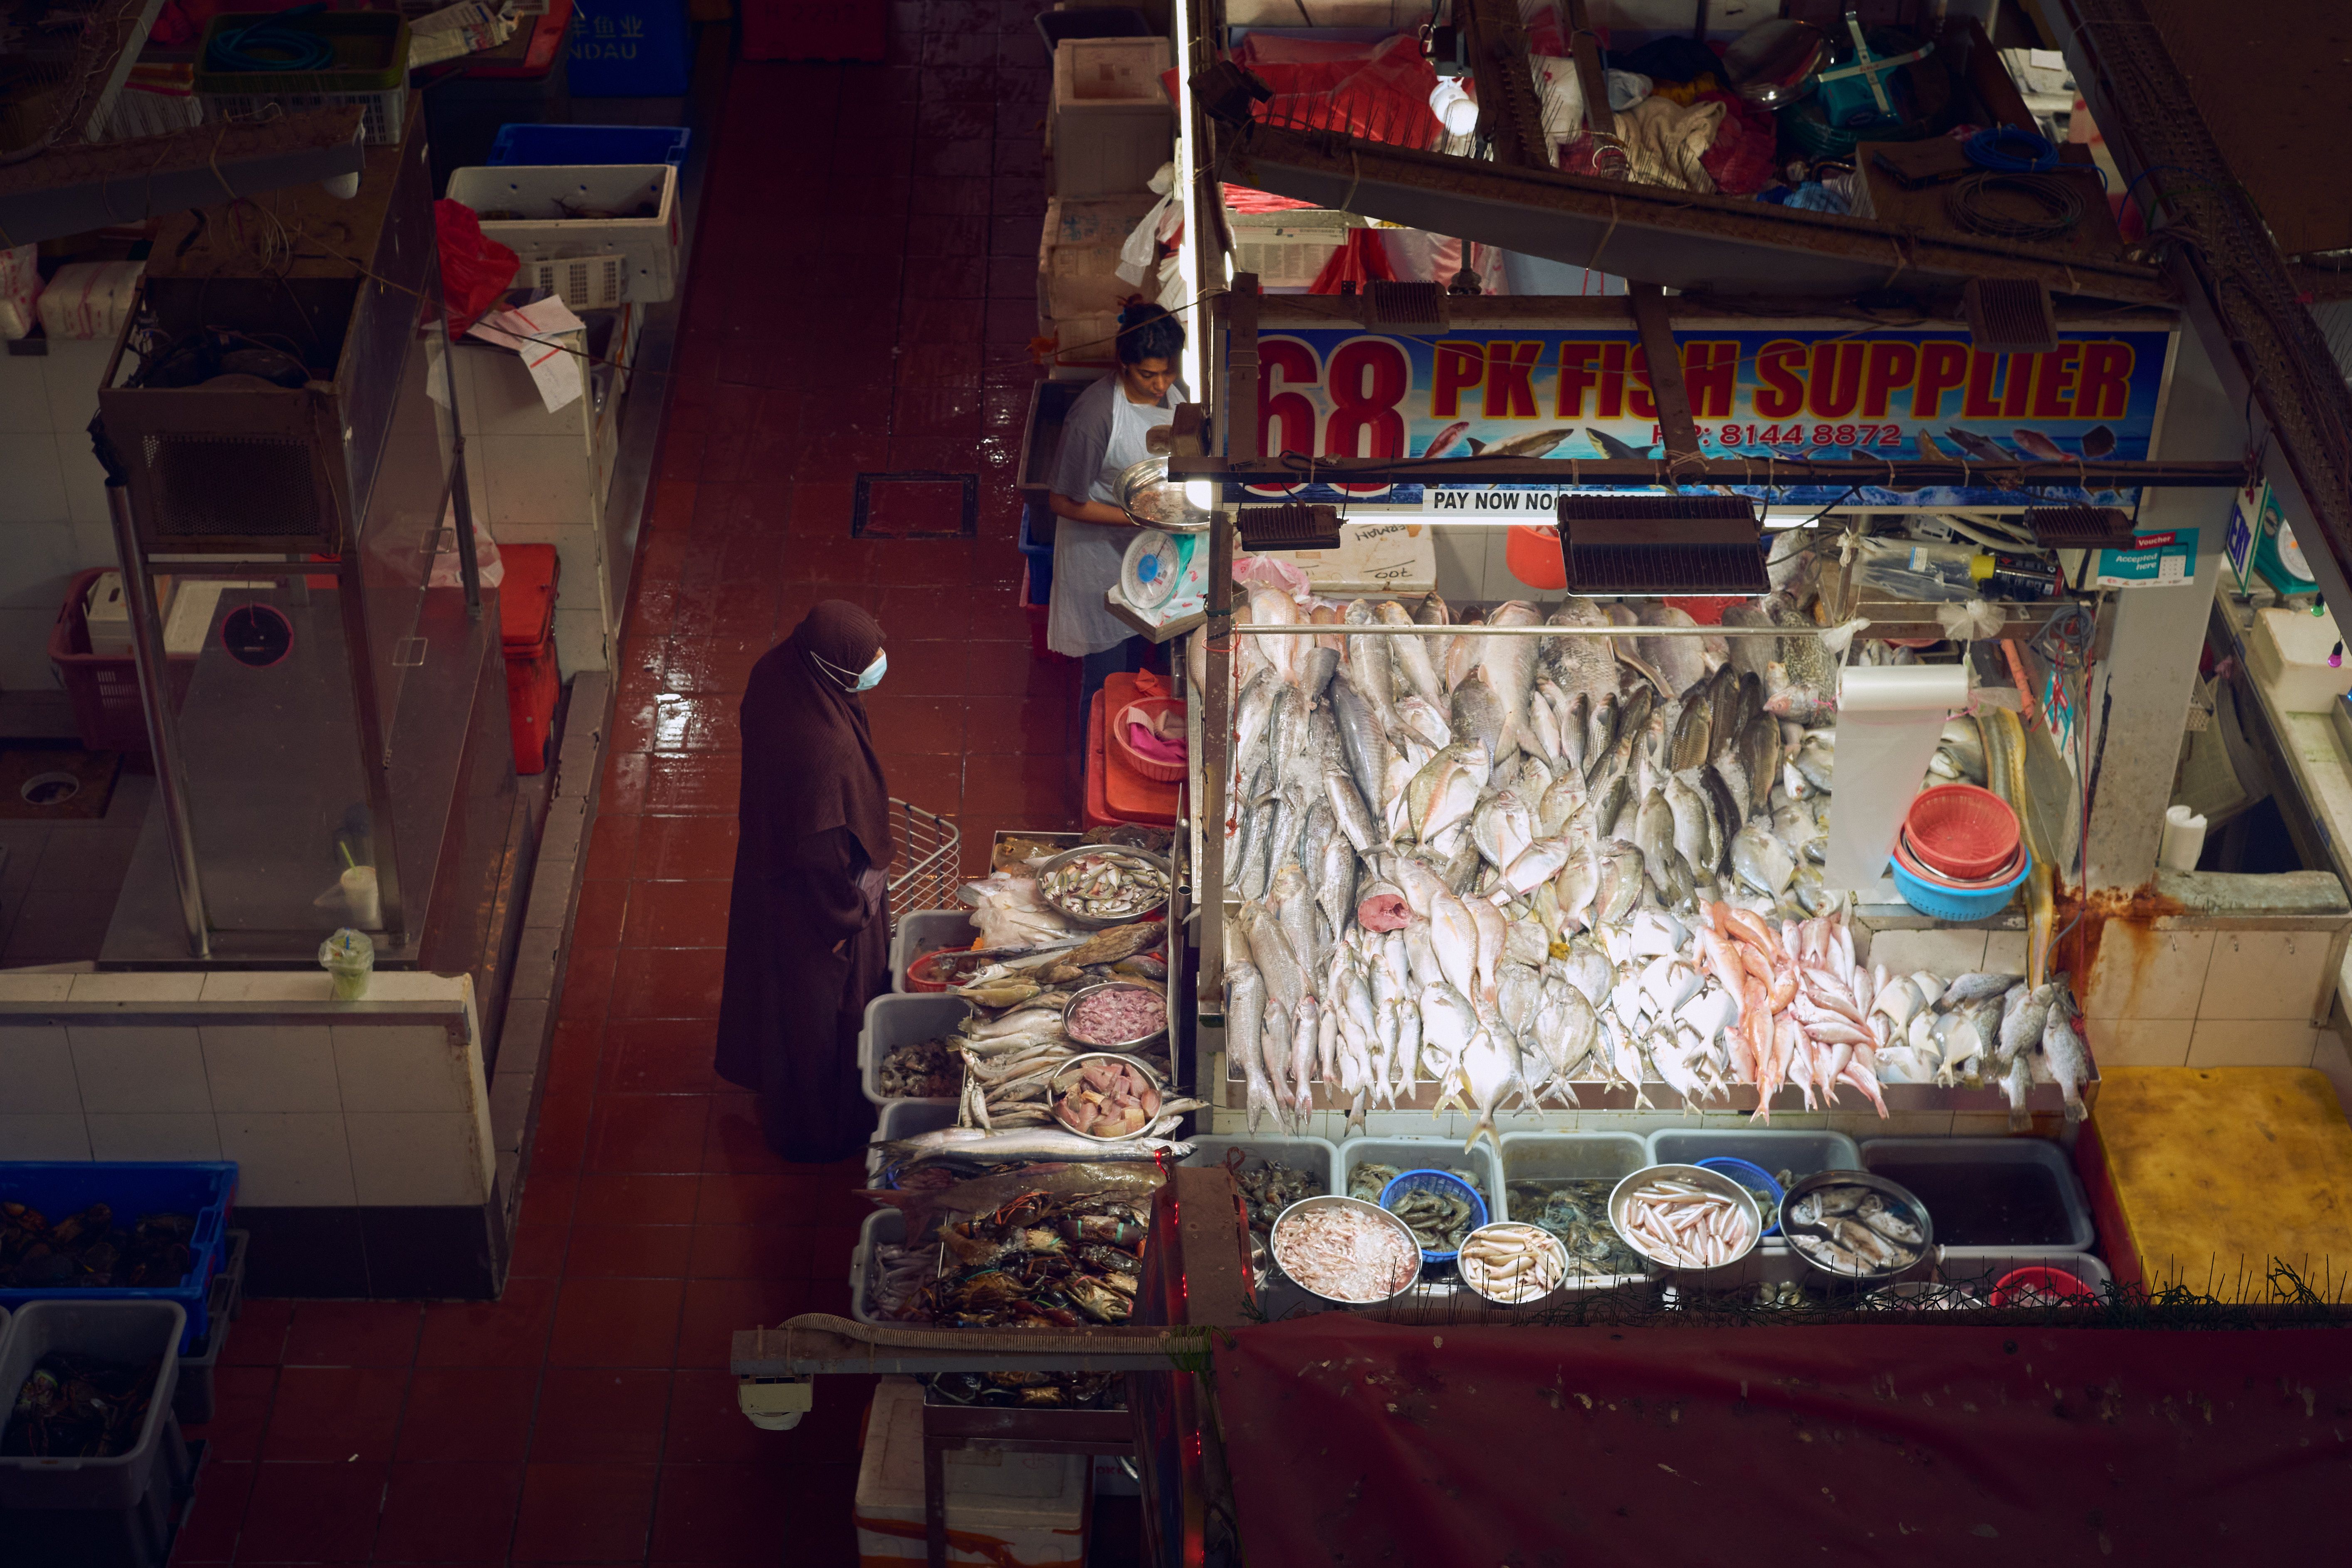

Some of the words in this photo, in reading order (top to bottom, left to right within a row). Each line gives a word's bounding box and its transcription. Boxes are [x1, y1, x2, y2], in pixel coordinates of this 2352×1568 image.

[1431, 341, 1544, 419] PK
[1555, 341, 1741, 419] FISH
[1752, 338, 2136, 420] SUPPLIER
[1240, 335, 1412, 497] 68
[1720, 424, 1803, 446] 8144
[1812, 424, 1901, 446] 8872
[1434, 492, 1468, 509] PAY
[1475, 492, 1519, 509] NOW
[2139, 536, 2171, 546] Voucher
[2116, 553, 2157, 564] Accepted
[2136, 561, 2157, 571] here
